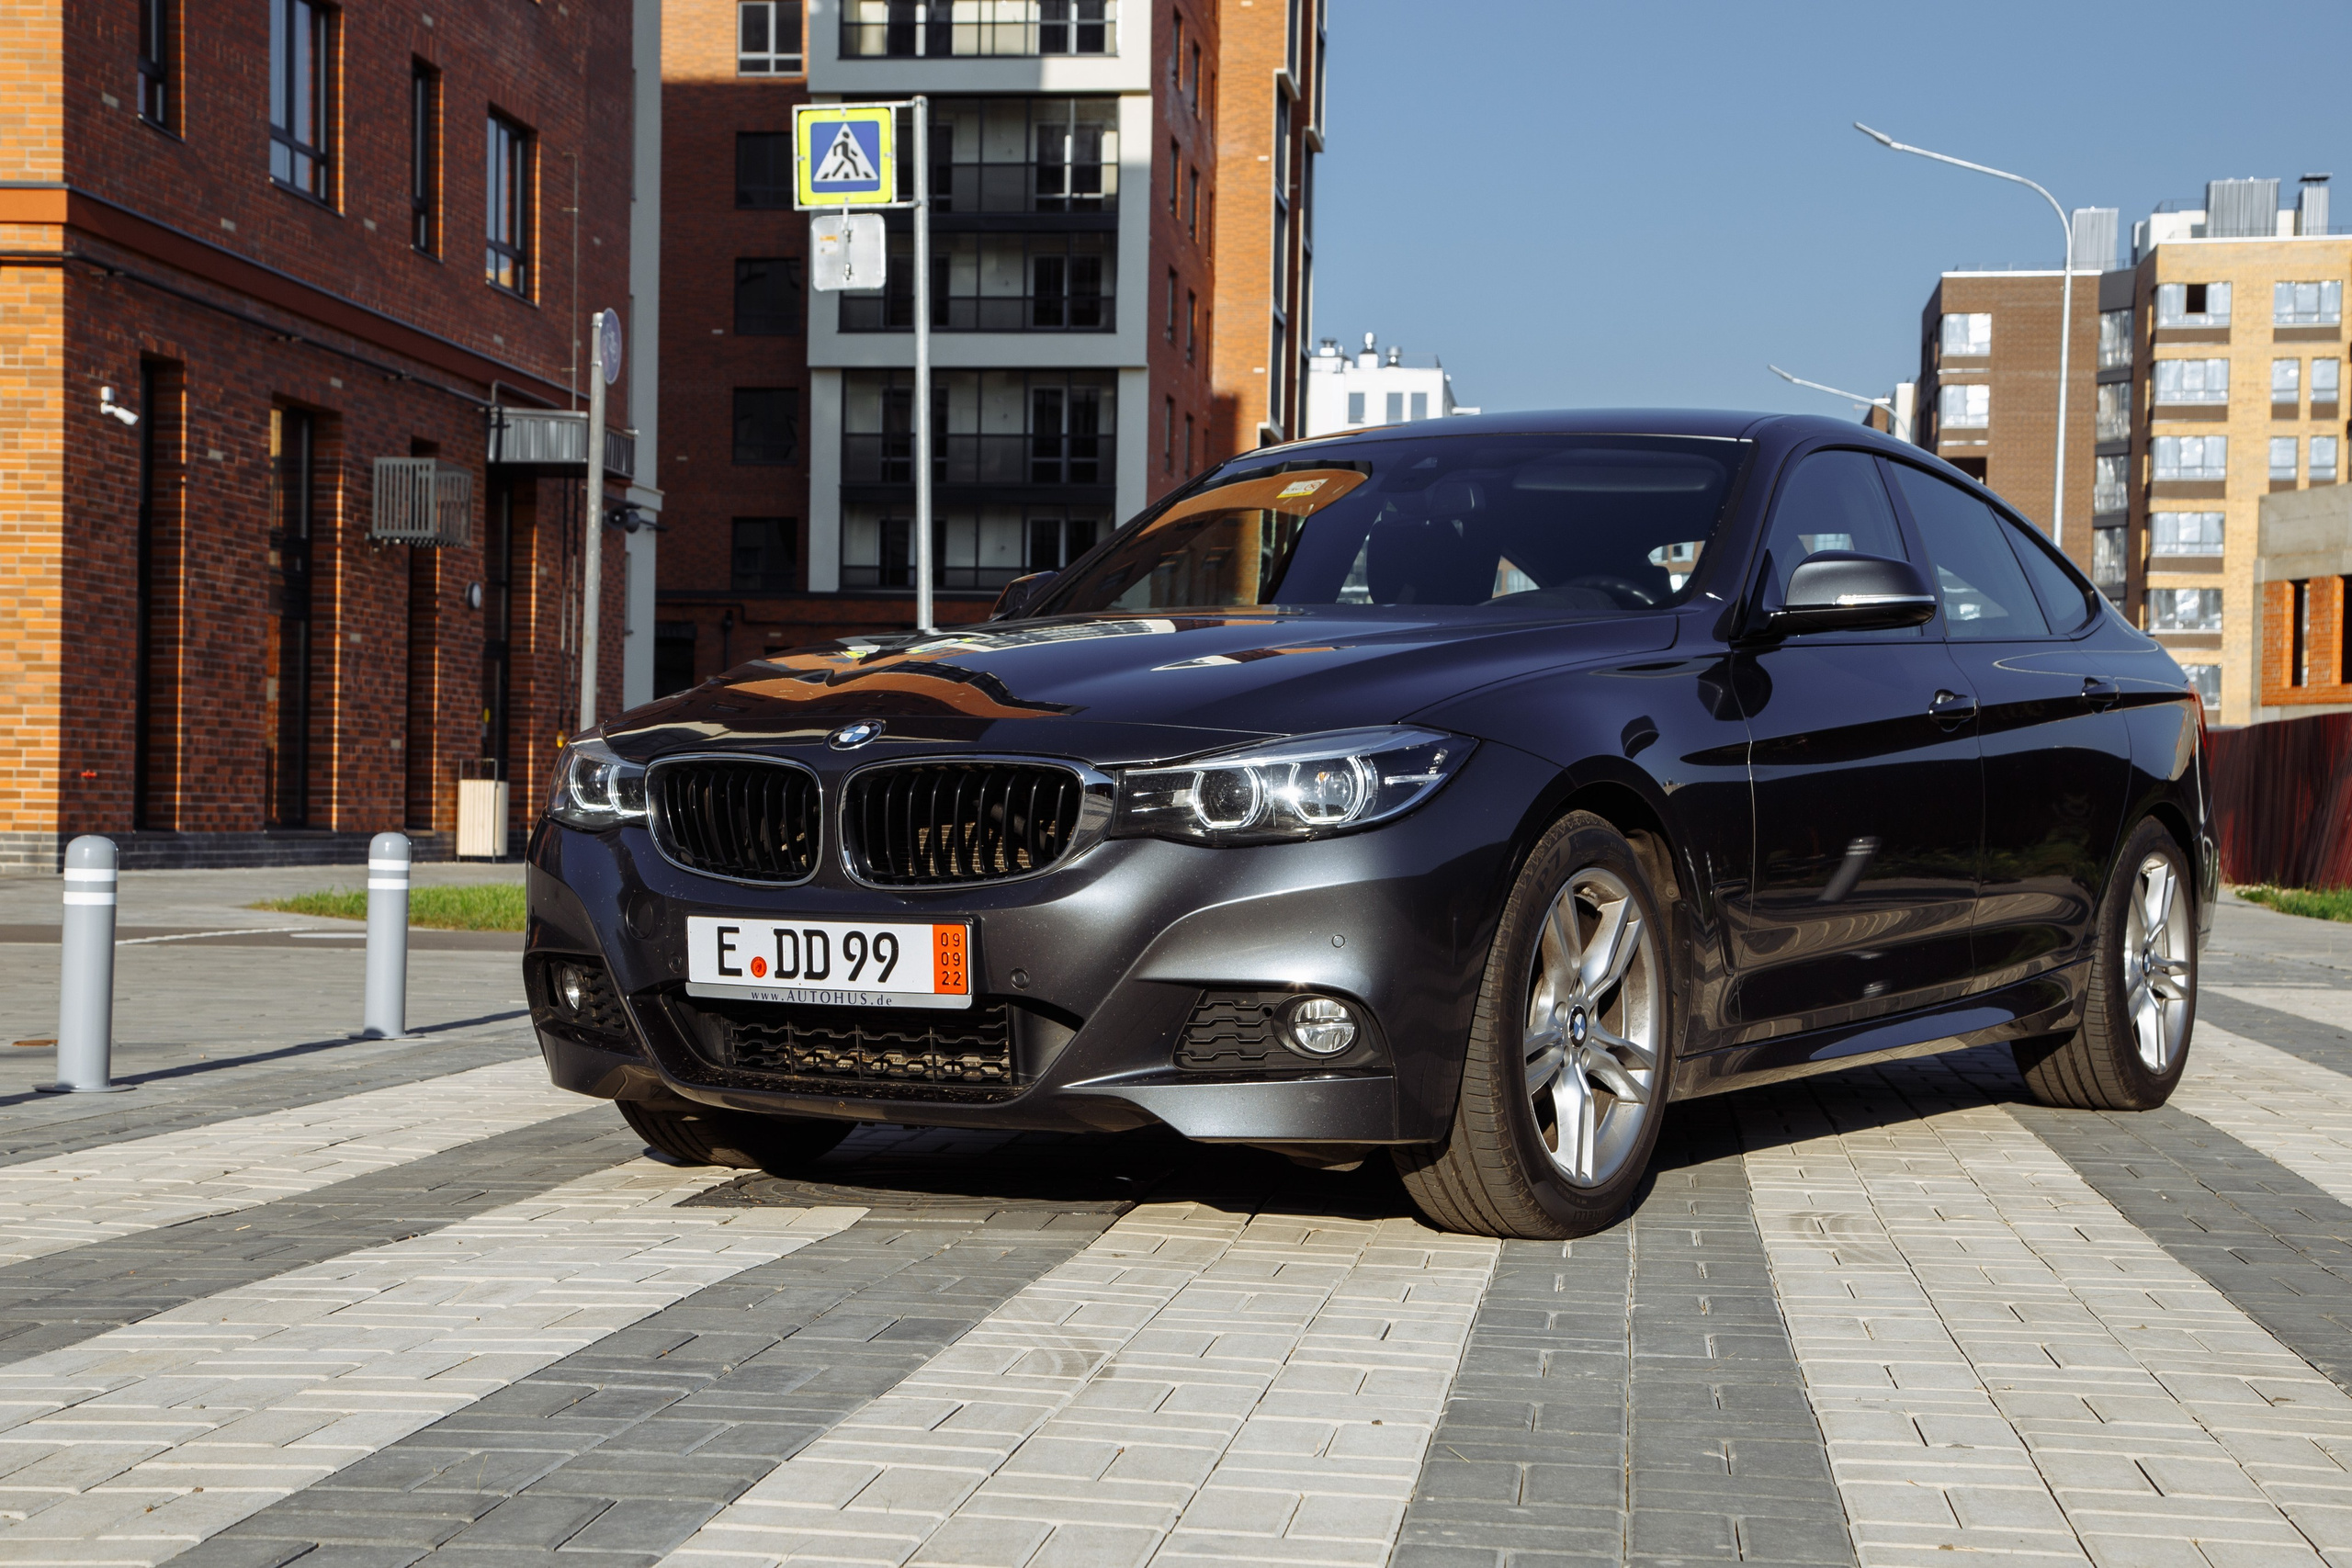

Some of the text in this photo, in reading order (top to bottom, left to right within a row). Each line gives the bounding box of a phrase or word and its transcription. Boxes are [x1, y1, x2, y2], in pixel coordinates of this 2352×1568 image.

[941, 932, 961, 947] 09
[718, 926, 742, 976] E
[774, 928, 831, 980] DD
[842, 931, 899, 983] 99
[941, 952, 961, 966] 09
[942, 971, 962, 987] 22
[751, 989, 892, 1006] www.AUTOHUS.de
